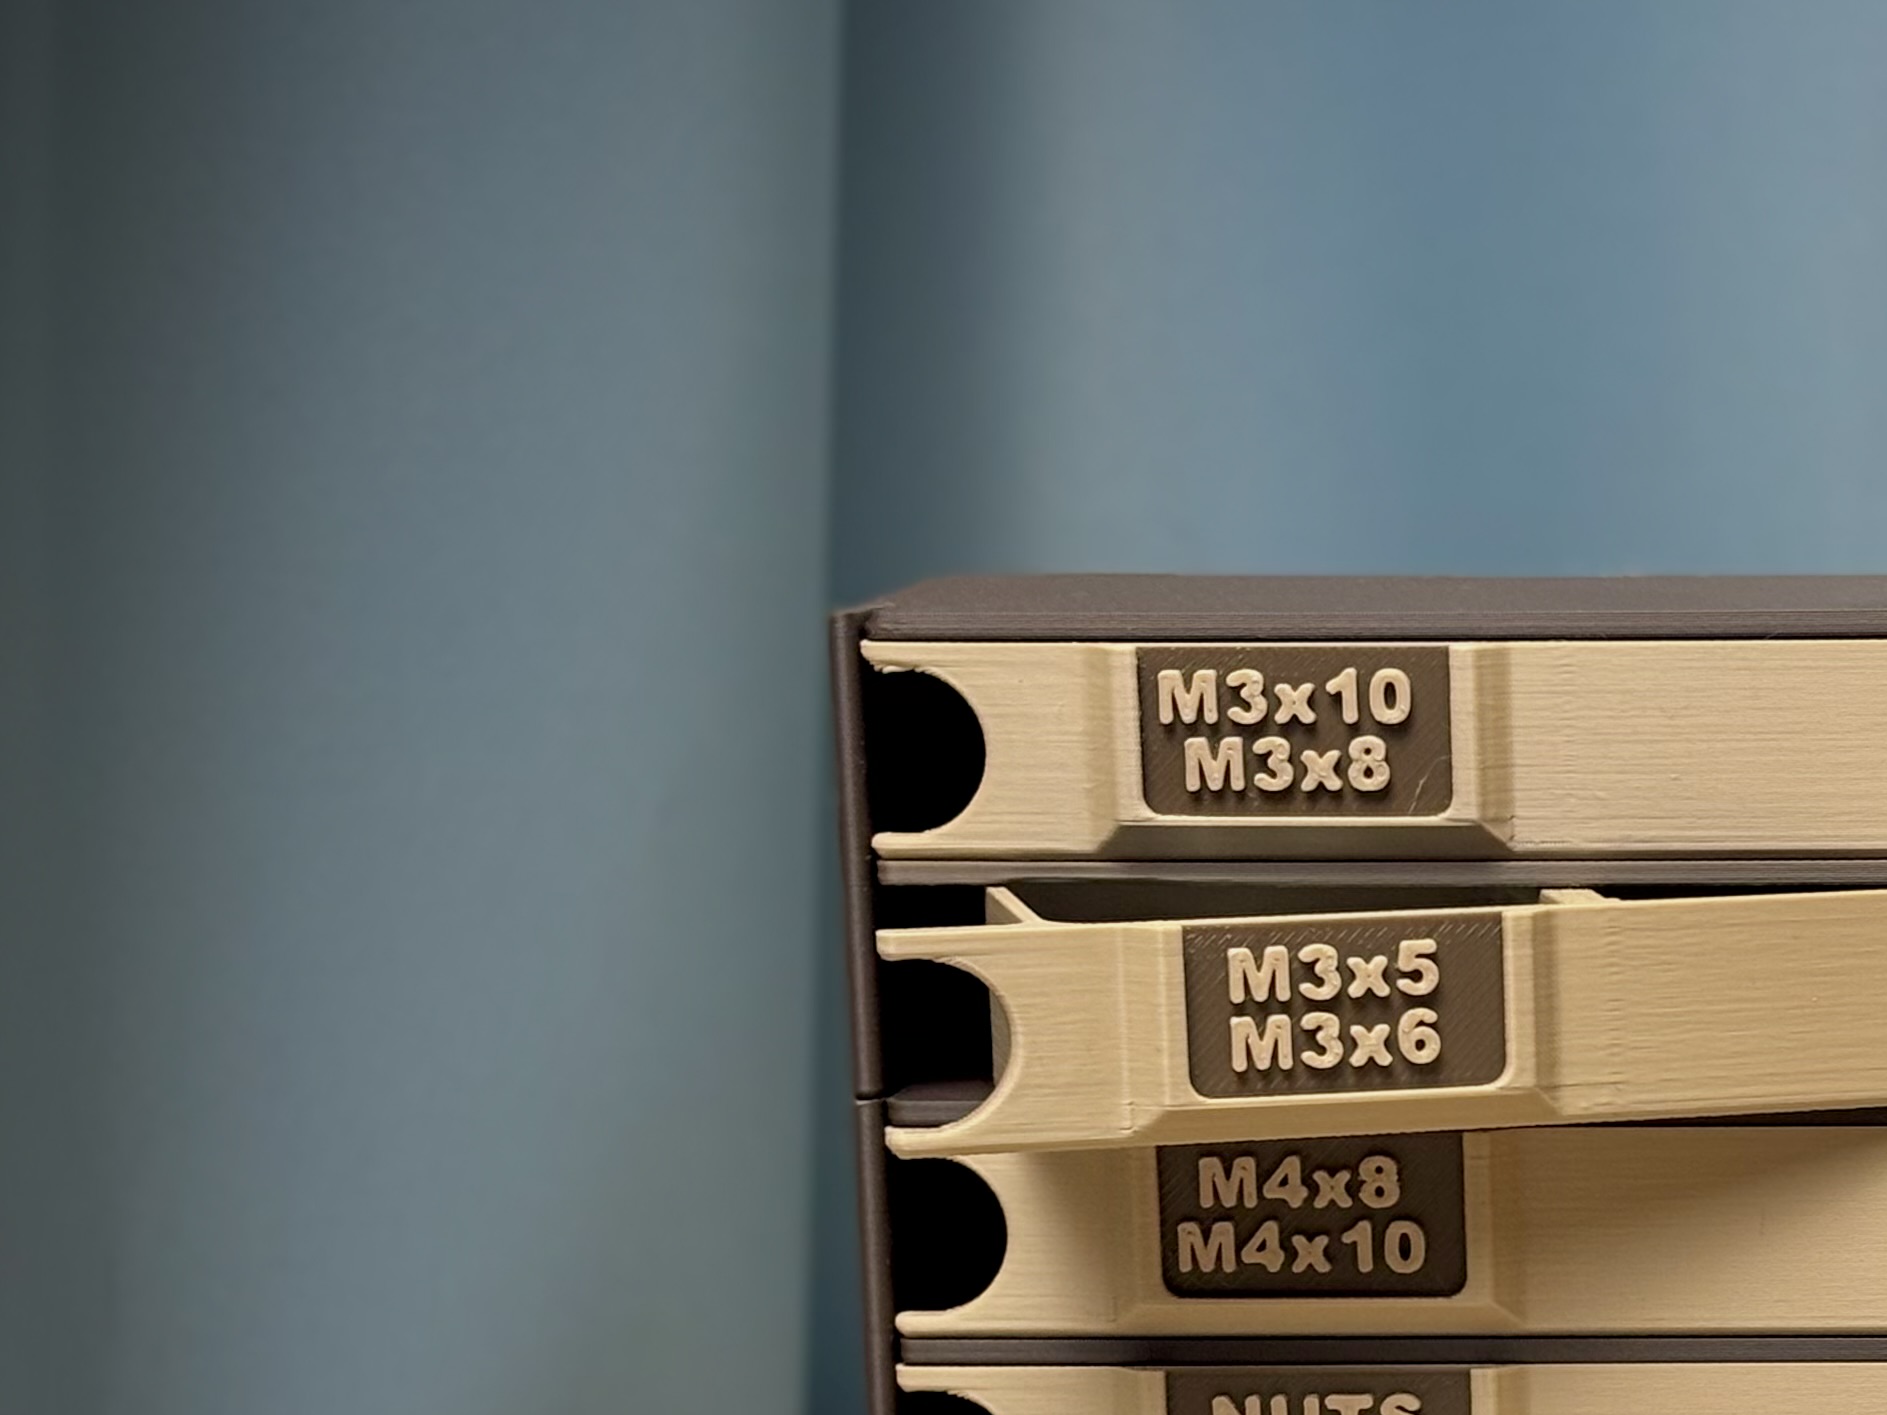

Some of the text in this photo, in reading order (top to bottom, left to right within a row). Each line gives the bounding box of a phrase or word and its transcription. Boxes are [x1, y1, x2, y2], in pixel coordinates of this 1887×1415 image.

[1157, 668, 1412, 726] M3x10
[1184, 736, 1391, 793] M3x8
[1227, 938, 1440, 1005] M3x5
[1230, 1008, 1442, 1073] M3x6
[1198, 1155, 1401, 1209] M4x8
[1177, 1220, 1426, 1274] M4x10
